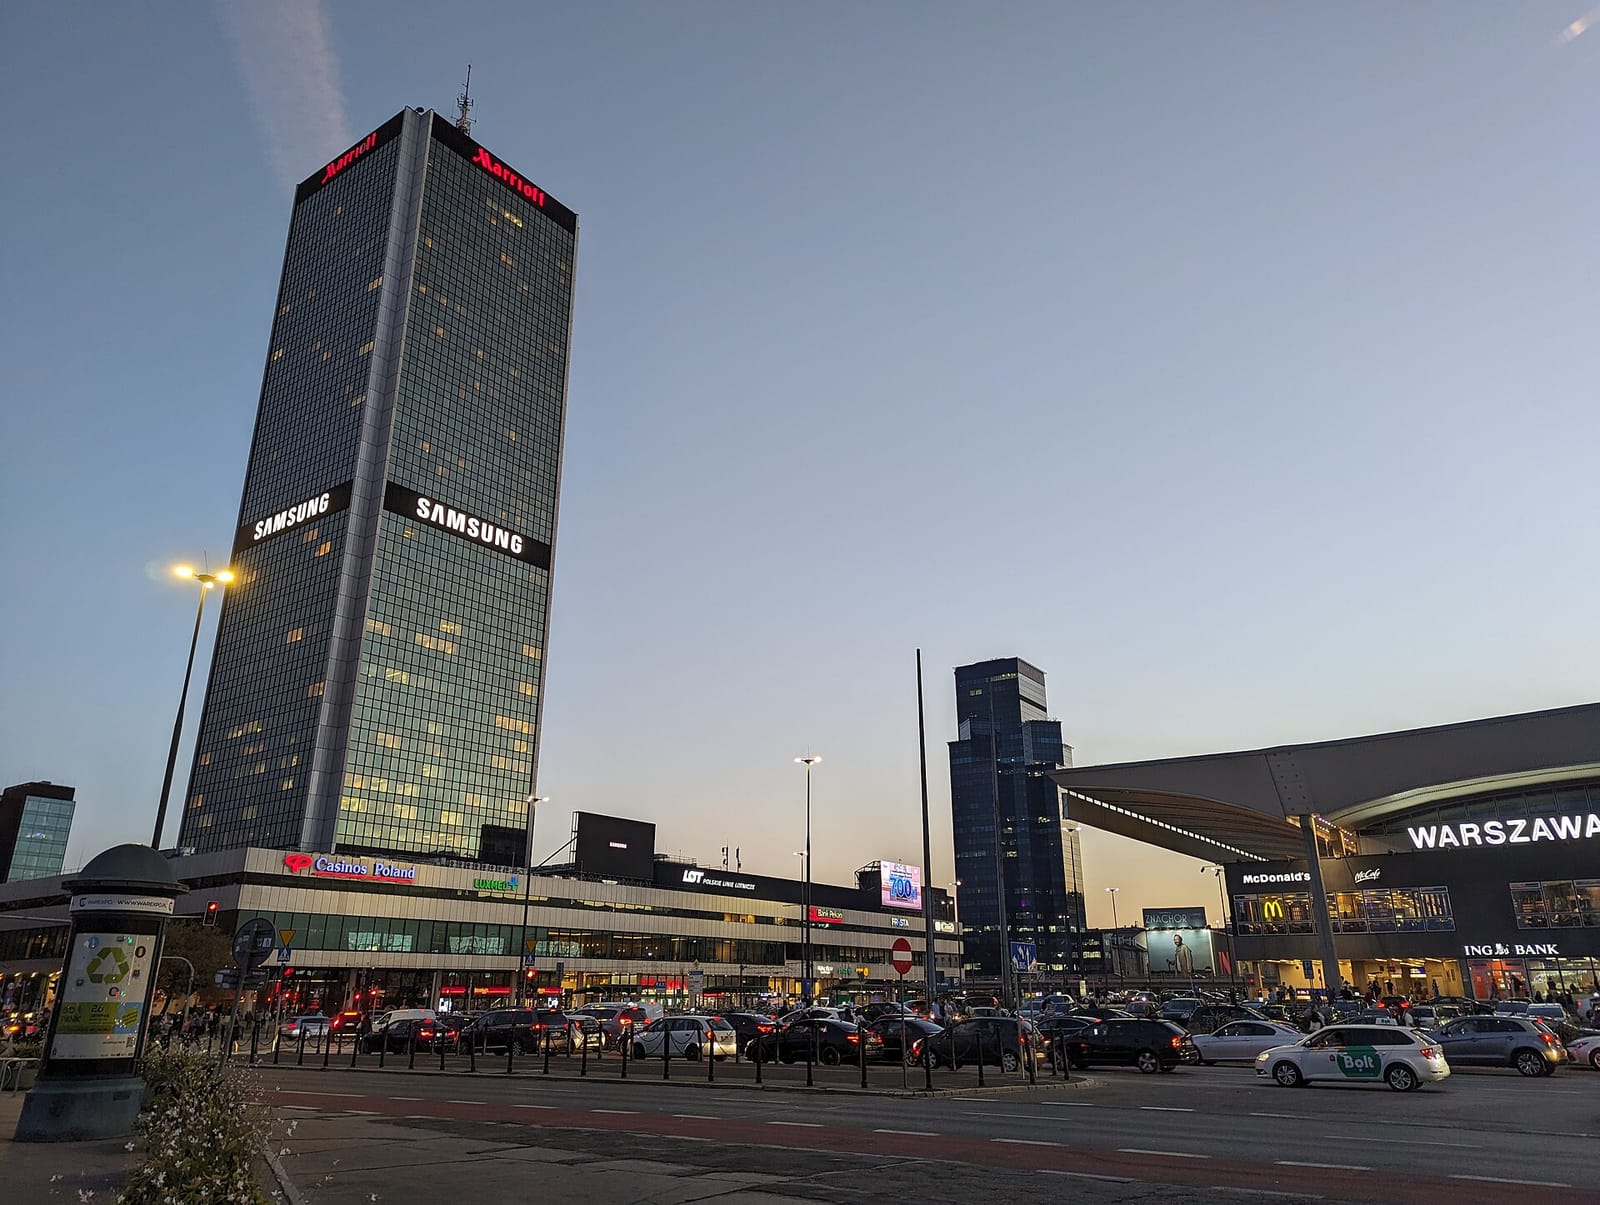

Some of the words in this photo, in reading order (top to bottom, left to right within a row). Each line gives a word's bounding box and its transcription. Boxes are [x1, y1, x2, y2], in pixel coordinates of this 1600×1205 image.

[473, 147, 545, 207] Marriott
[253, 492, 330, 541] SAMSUNG
[416, 497, 523, 555] SAMSUNG
[1407, 813, 1600, 849] WARSZAWA
[315, 857, 367, 875] Casinos
[373, 862, 416, 879] Poland
[682, 869, 705, 884] LOT
[1242, 872, 1311, 884] McDonald's
[889, 876, 912, 898] 700
[1144, 913, 1188, 924] ZNACHOR
[1464, 945, 1493, 956] ING
[1514, 943, 1560, 955] BANK
[1343, 1054, 1375, 1072] Bolt
